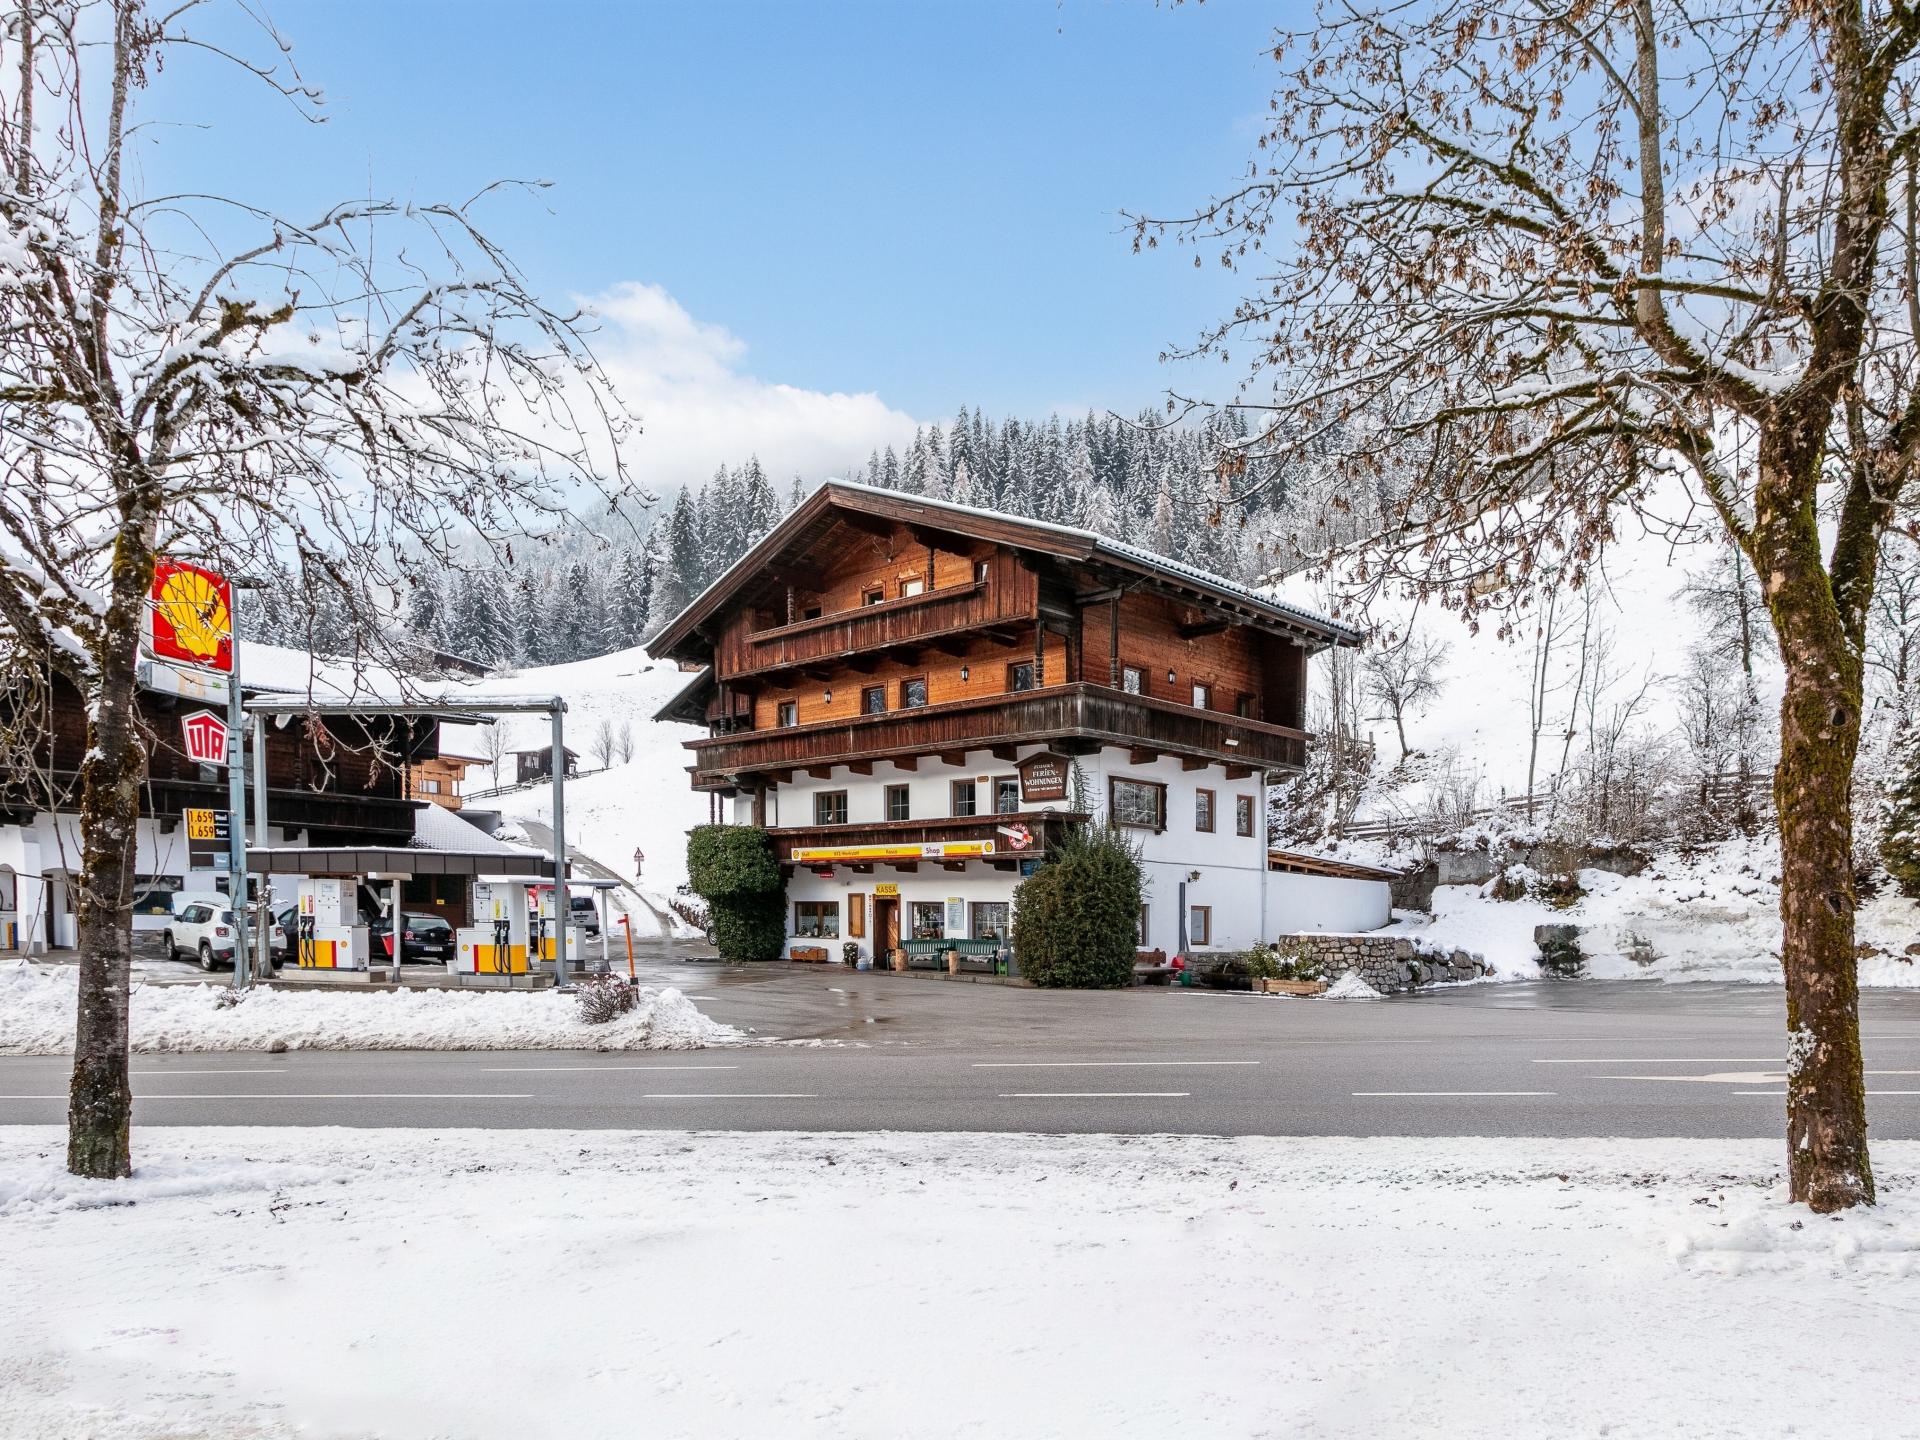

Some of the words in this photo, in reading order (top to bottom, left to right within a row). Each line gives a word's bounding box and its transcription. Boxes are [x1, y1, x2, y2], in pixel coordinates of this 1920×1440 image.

[187, 715, 225, 761] UTA
[190, 811, 213, 822] 1.659
[191, 826, 214, 838] 1.659
[216, 829, 228, 837] Super
[926, 847, 940, 855] Shop
[876, 885, 897, 894] KASSA
